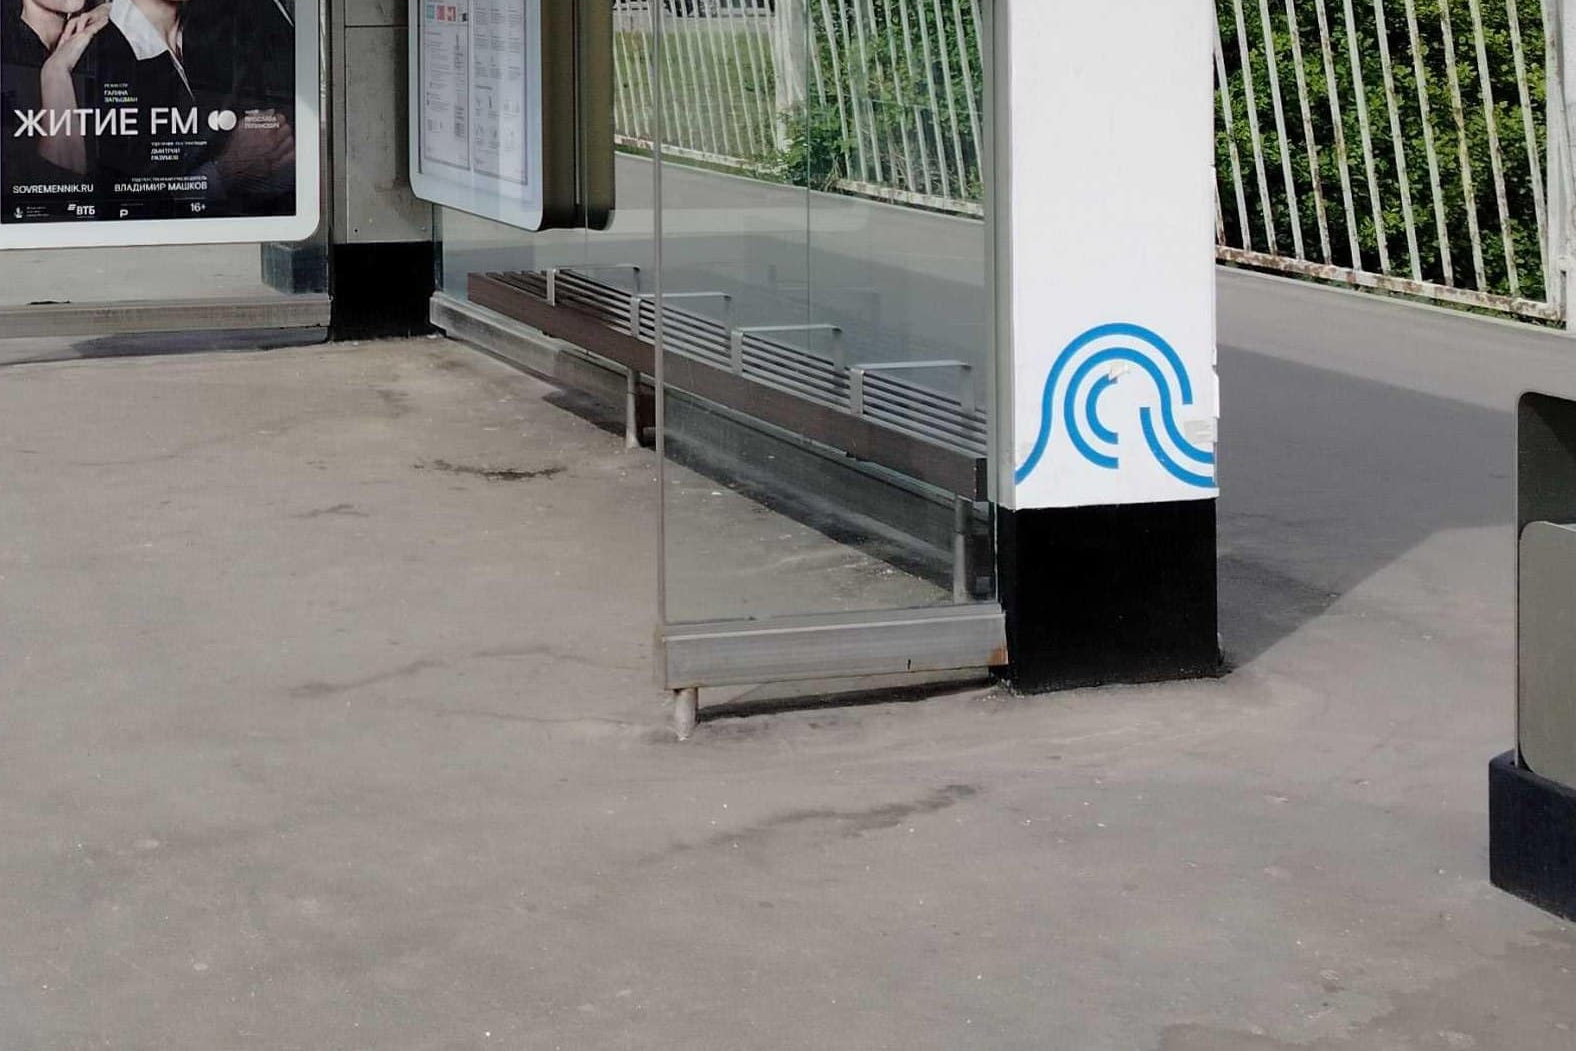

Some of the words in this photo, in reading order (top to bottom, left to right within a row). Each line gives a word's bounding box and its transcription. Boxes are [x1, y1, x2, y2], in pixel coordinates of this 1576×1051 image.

[13, 107, 138, 138] ЖИТИЕ
[150, 106, 198, 135] FM
[12, 183, 94, 194] SOVREMENNIK.RU
[114, 182, 166, 193] ВЛАДИМИР
[167, 181, 208, 191] МАШКОВ
[76, 205, 96, 215] ВТБ
[189, 202, 206, 212] 16+
